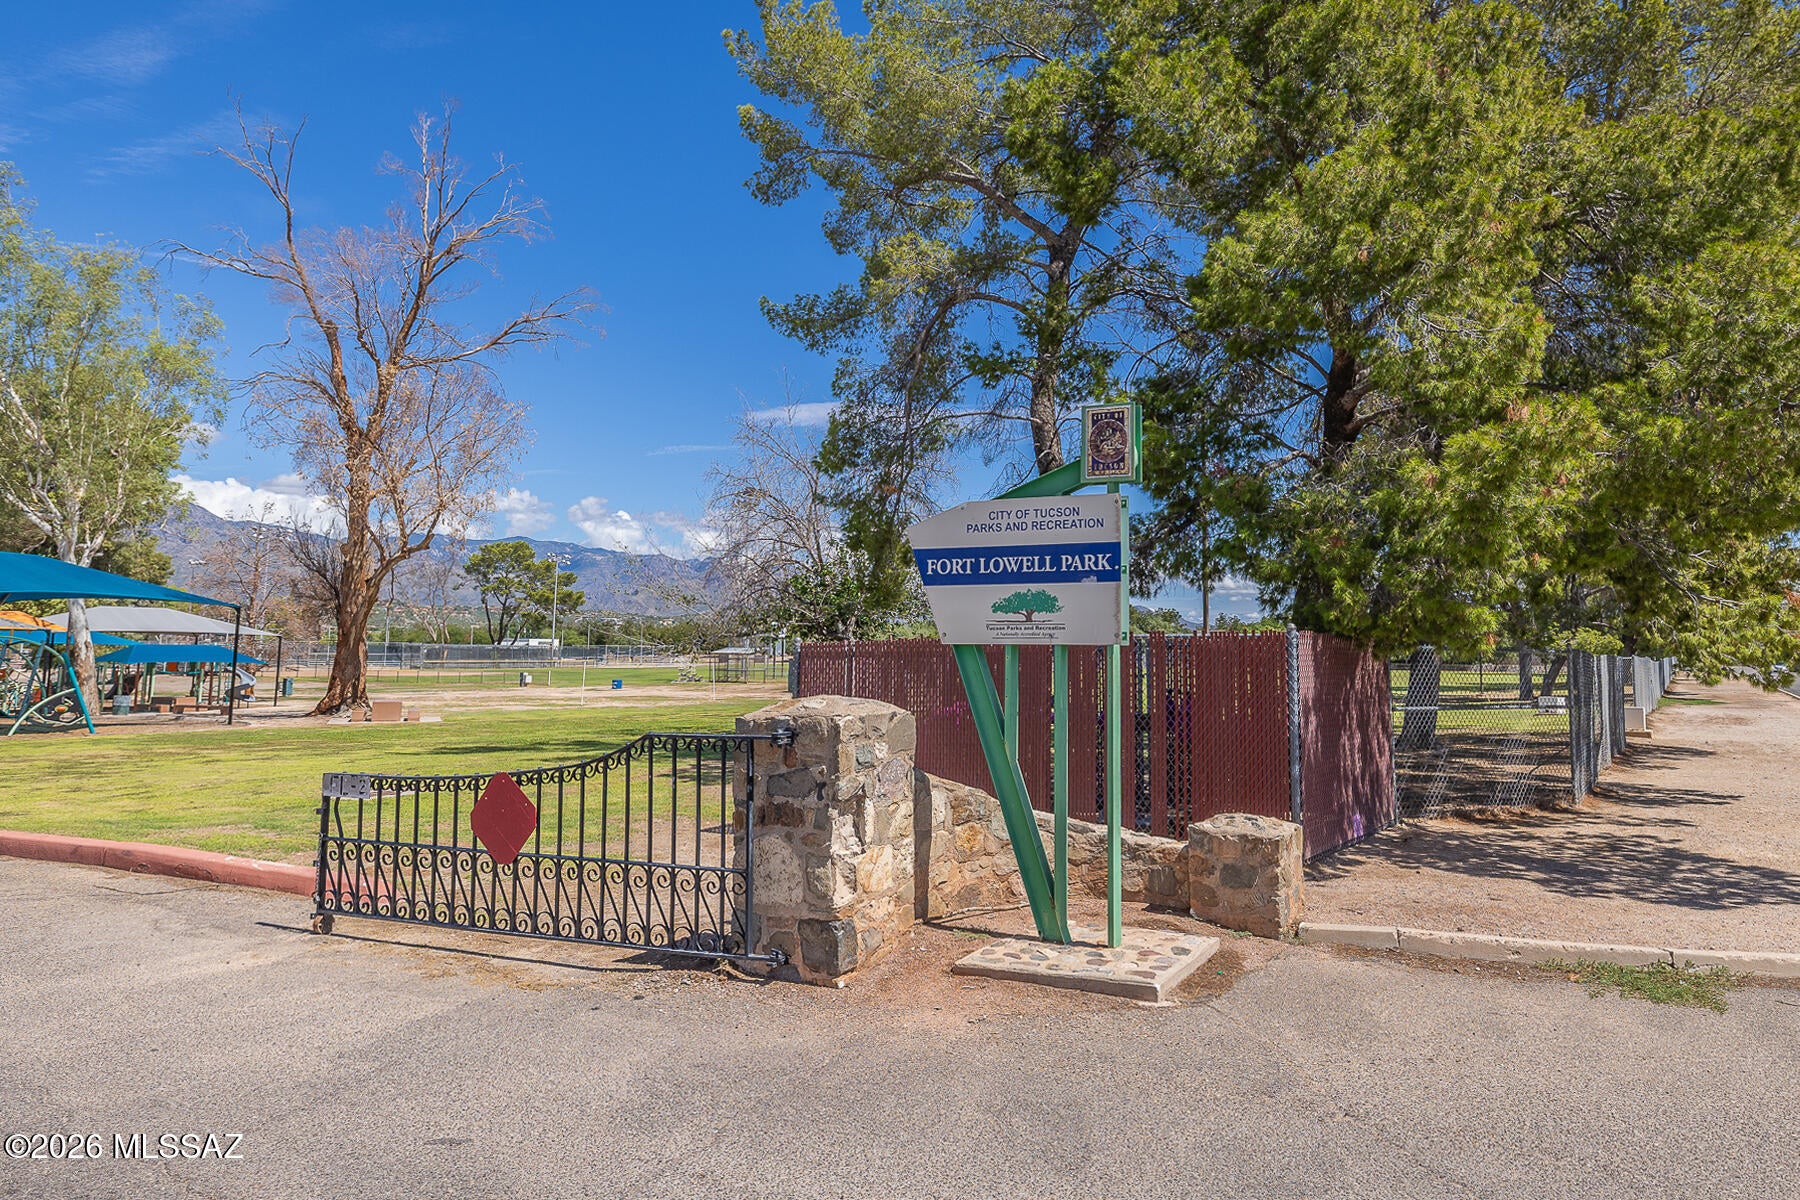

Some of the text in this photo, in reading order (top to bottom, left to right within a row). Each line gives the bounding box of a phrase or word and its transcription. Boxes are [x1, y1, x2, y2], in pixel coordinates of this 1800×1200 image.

[988, 506, 1080, 520] CITY OF TUCSON
[966, 518, 1104, 533] PARKS AND RECREATION
[926, 558, 975, 575] FORT
[979, 555, 1057, 574] LOWELL
